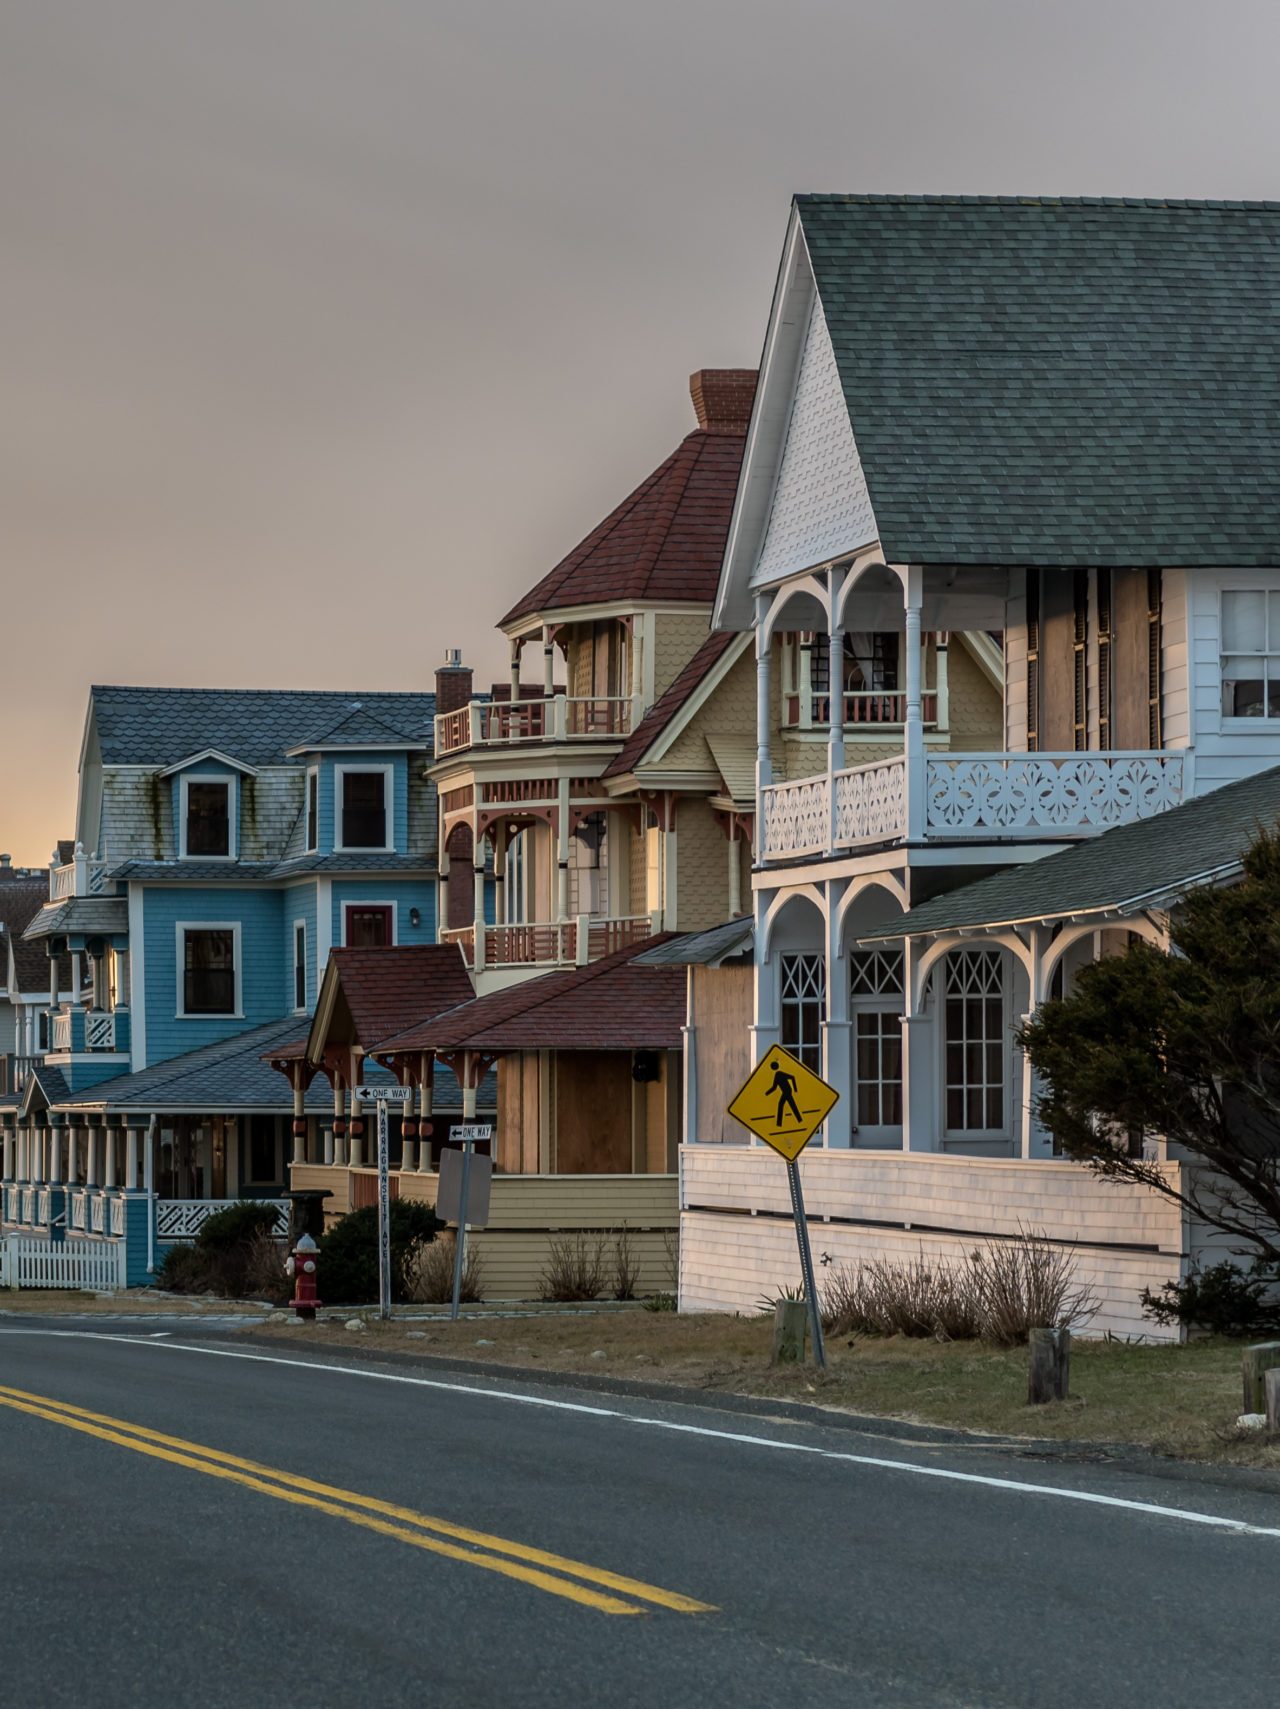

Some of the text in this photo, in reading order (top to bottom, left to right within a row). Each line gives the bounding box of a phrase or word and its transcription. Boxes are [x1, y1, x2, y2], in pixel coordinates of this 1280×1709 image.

[372, 1088, 408, 1099] ONE WAY
[462, 1126, 490, 1138] ONE WAY
[380, 1108, 388, 1223] NARRAGANSETT
